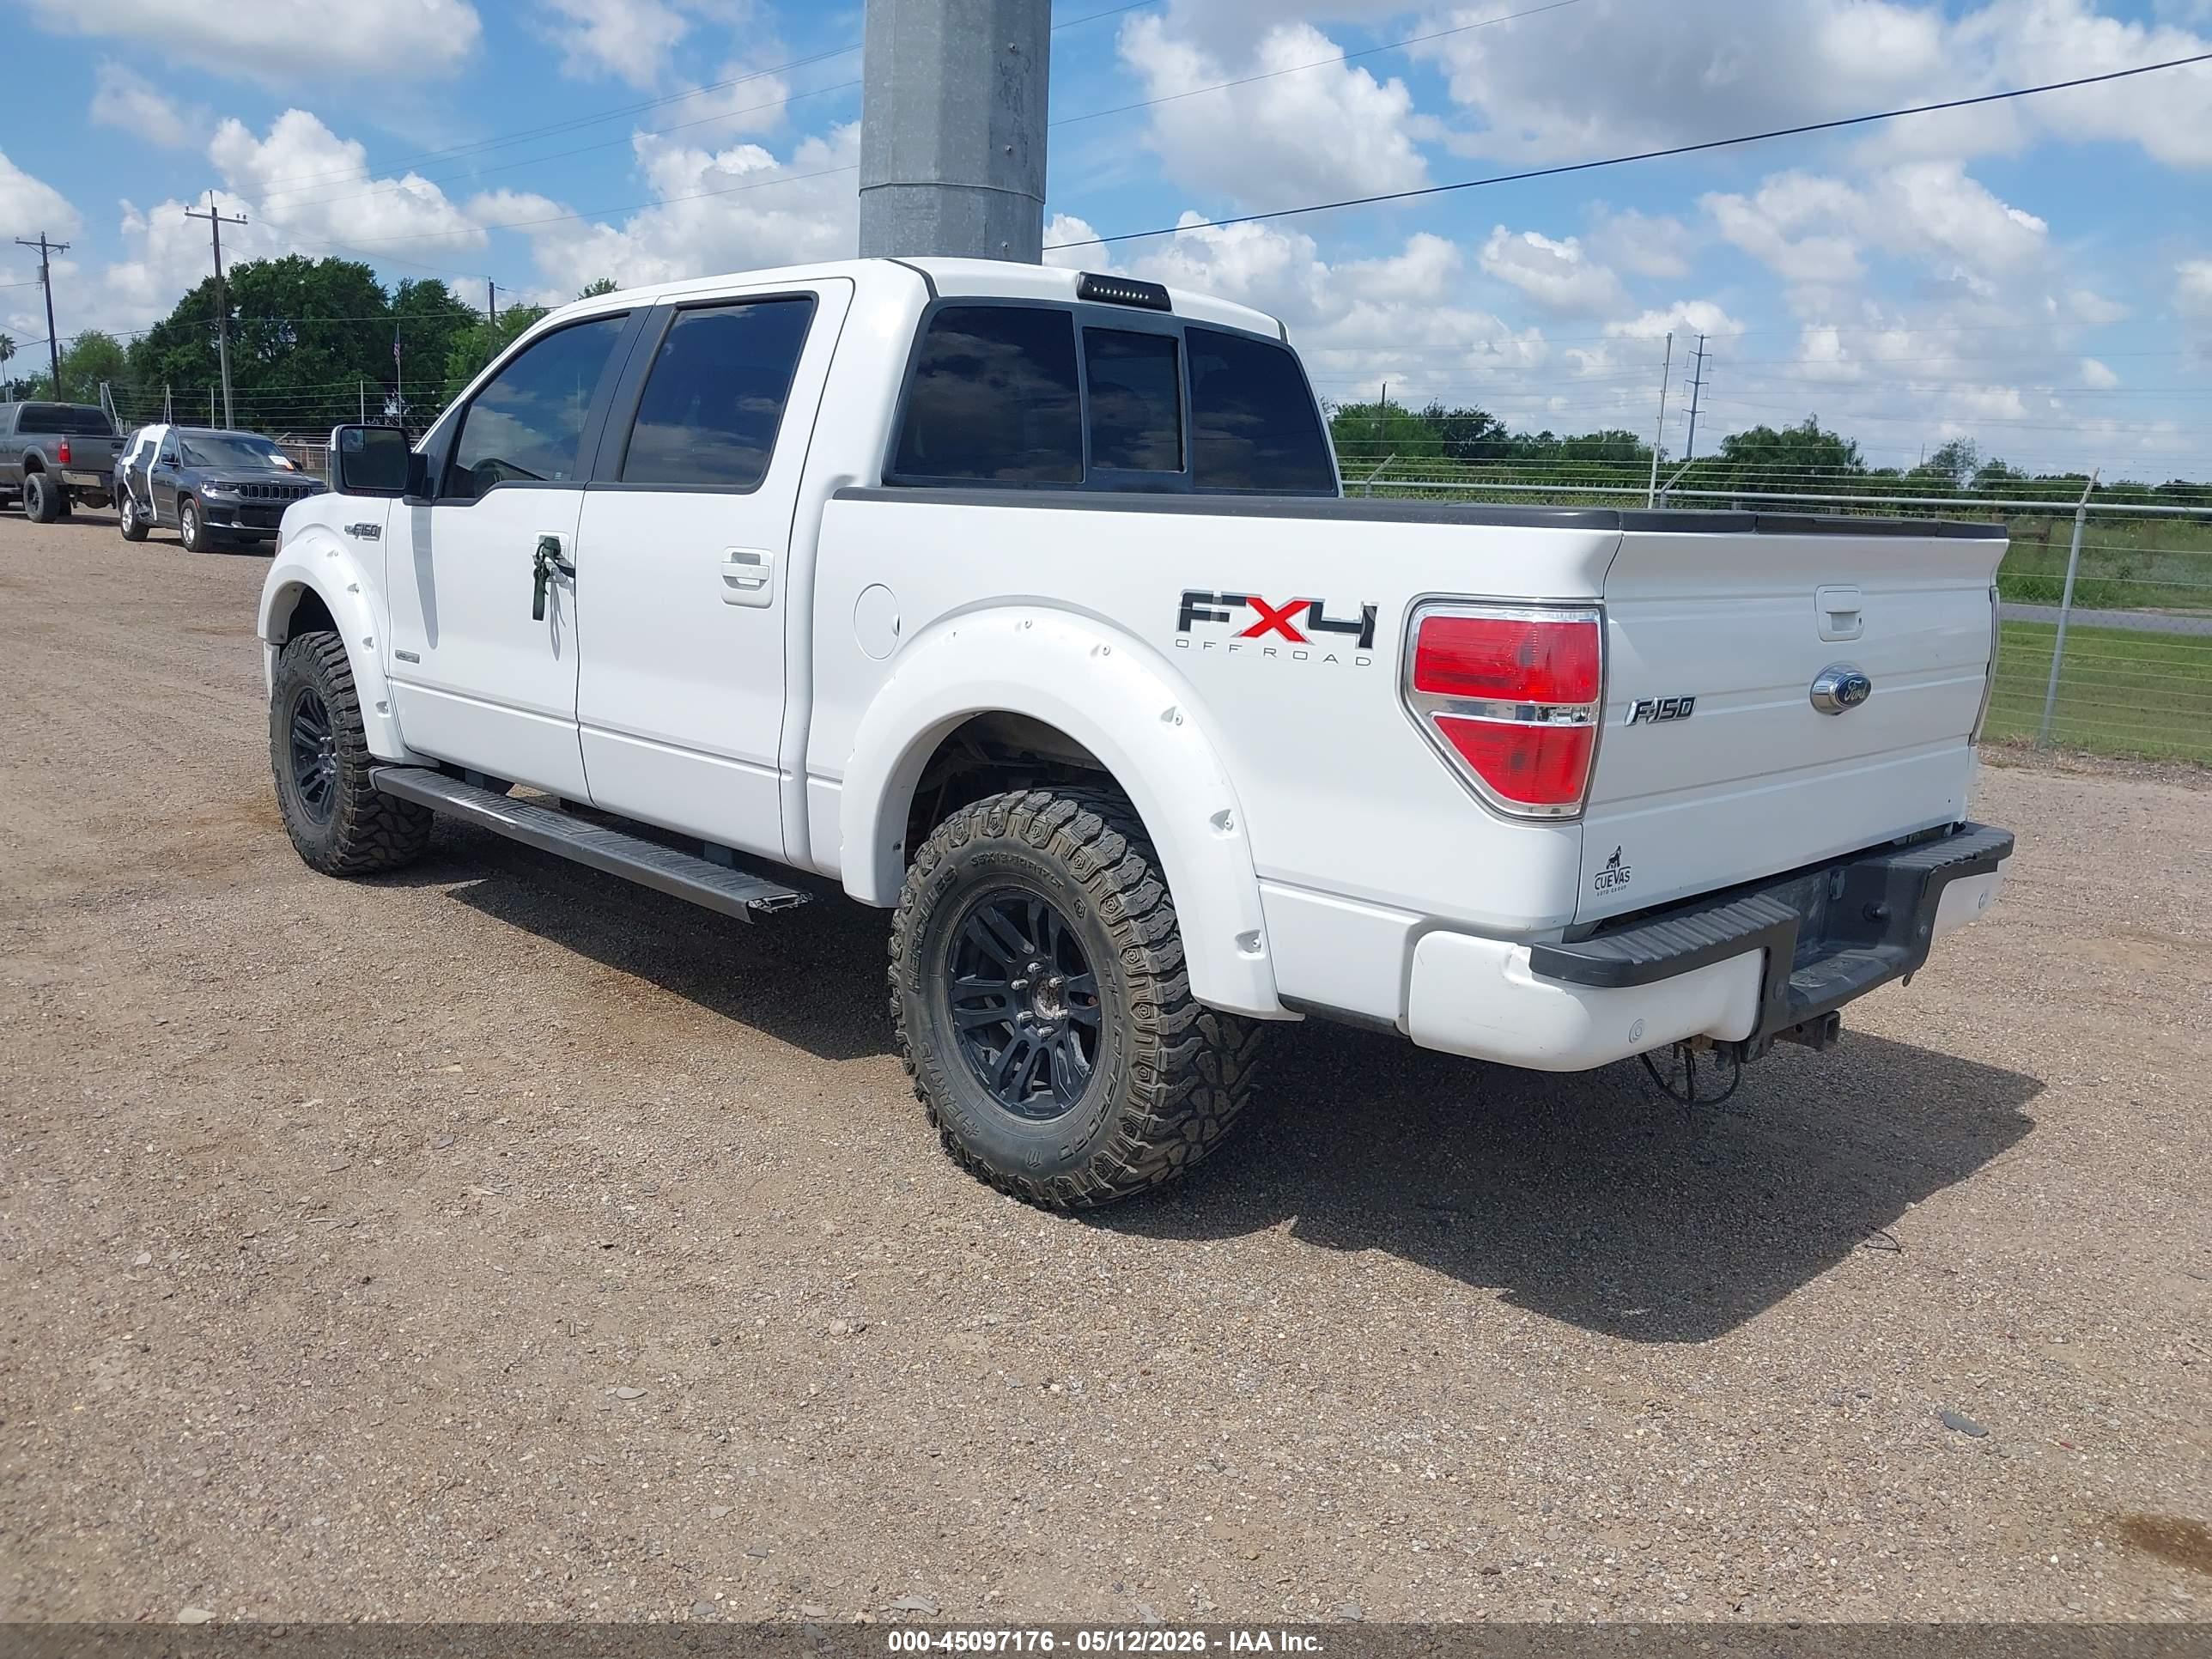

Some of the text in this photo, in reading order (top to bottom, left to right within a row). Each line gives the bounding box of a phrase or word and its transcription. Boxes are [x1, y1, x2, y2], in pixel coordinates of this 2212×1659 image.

[1176, 588, 1377, 650] FX4
[1844, 679, 1868, 702] Ford
[1625, 695, 1697, 726] F-150
[1594, 866, 1632, 890] CUEVAS
[906, 865, 959, 995] HERCULES
